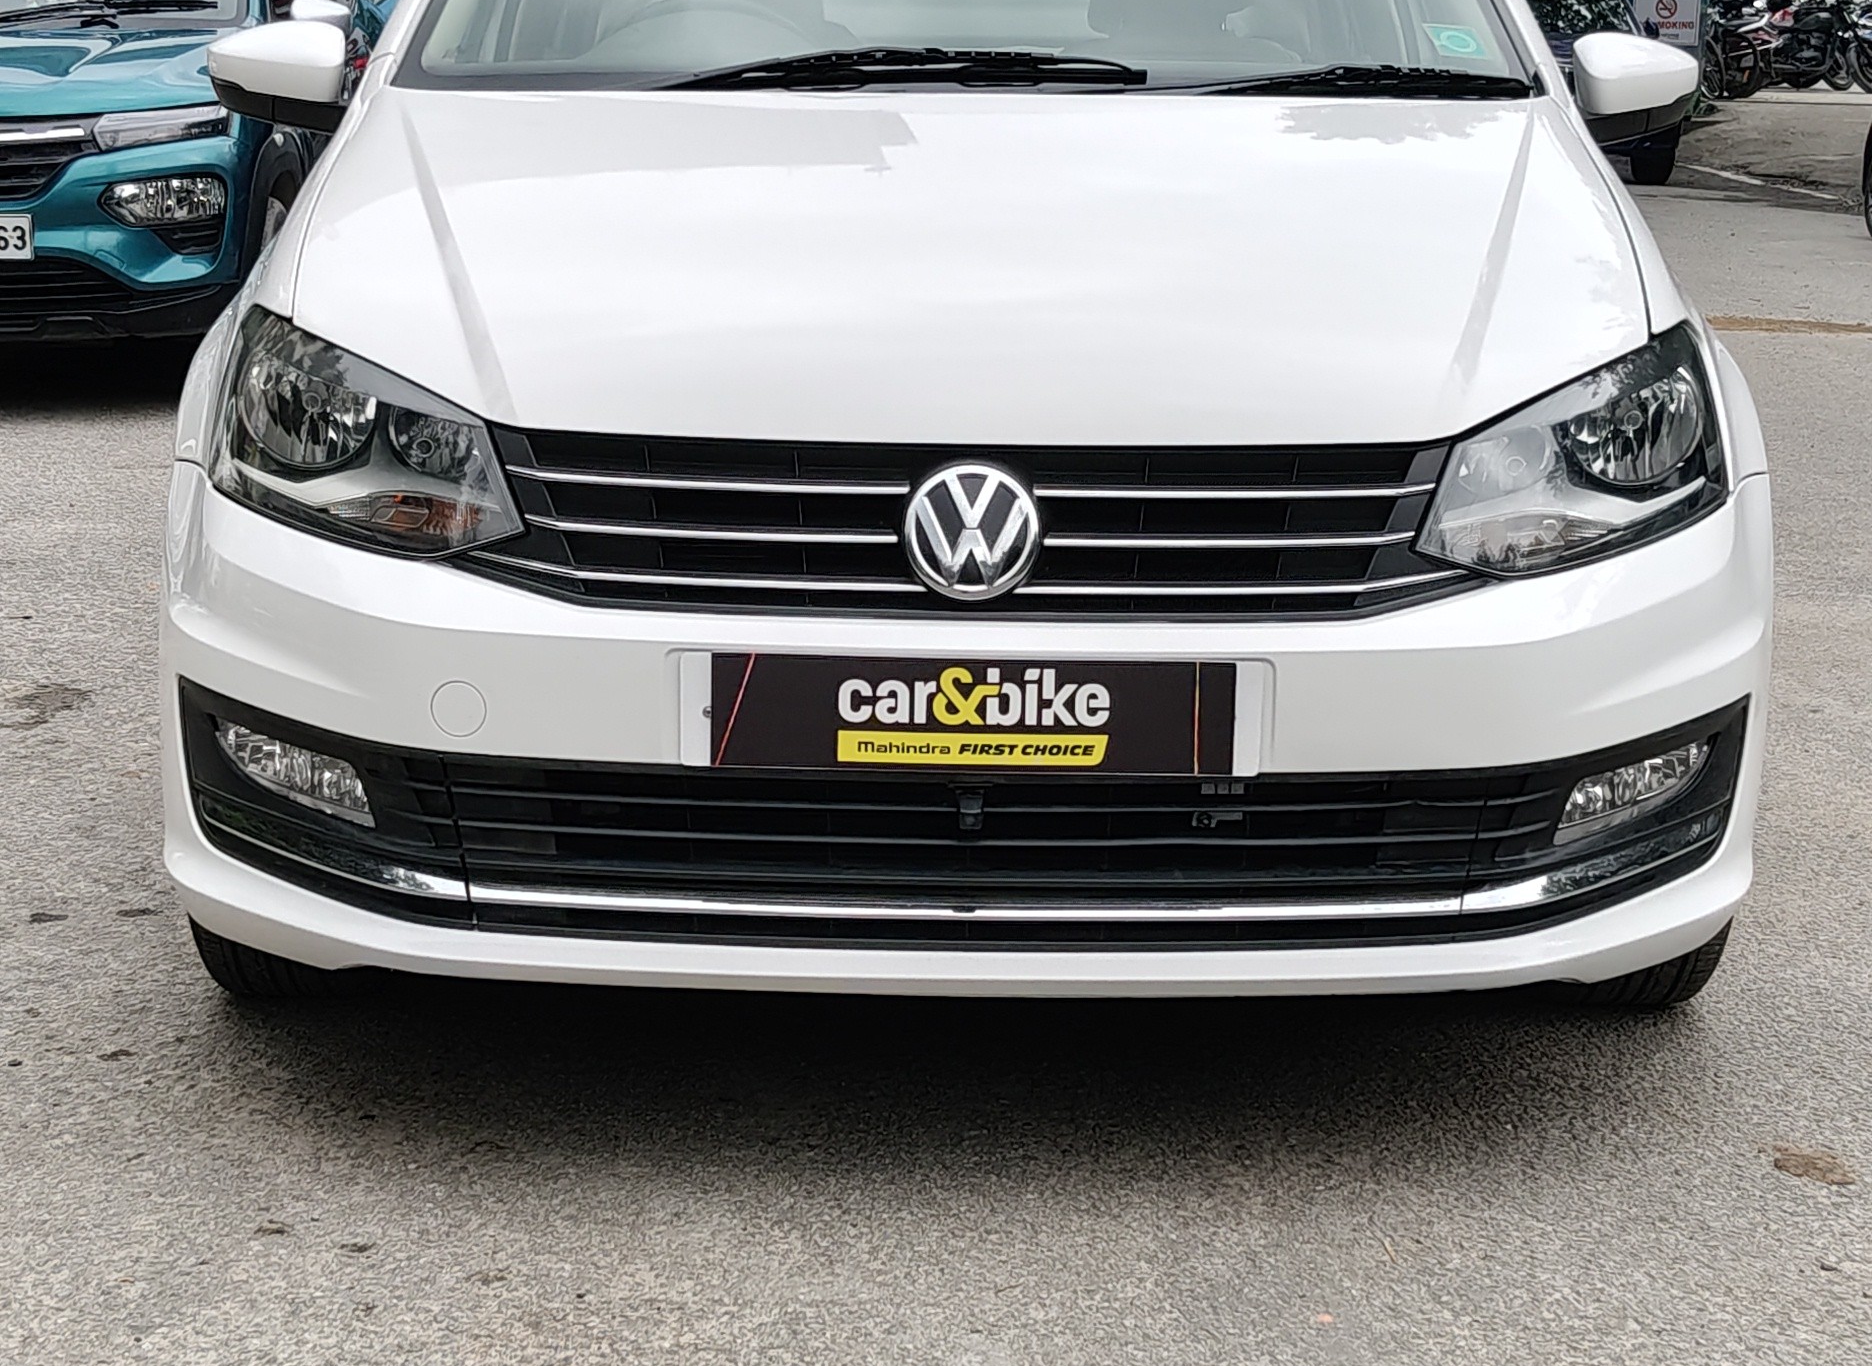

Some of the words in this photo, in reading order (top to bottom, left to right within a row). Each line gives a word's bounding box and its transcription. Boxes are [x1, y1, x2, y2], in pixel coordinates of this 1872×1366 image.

[837, 666, 1111, 727] car&bike
[857, 741, 951, 755] Mahindra
[958, 743, 1019, 756] FIRST
[1020, 744, 1096, 756] CHOICE
